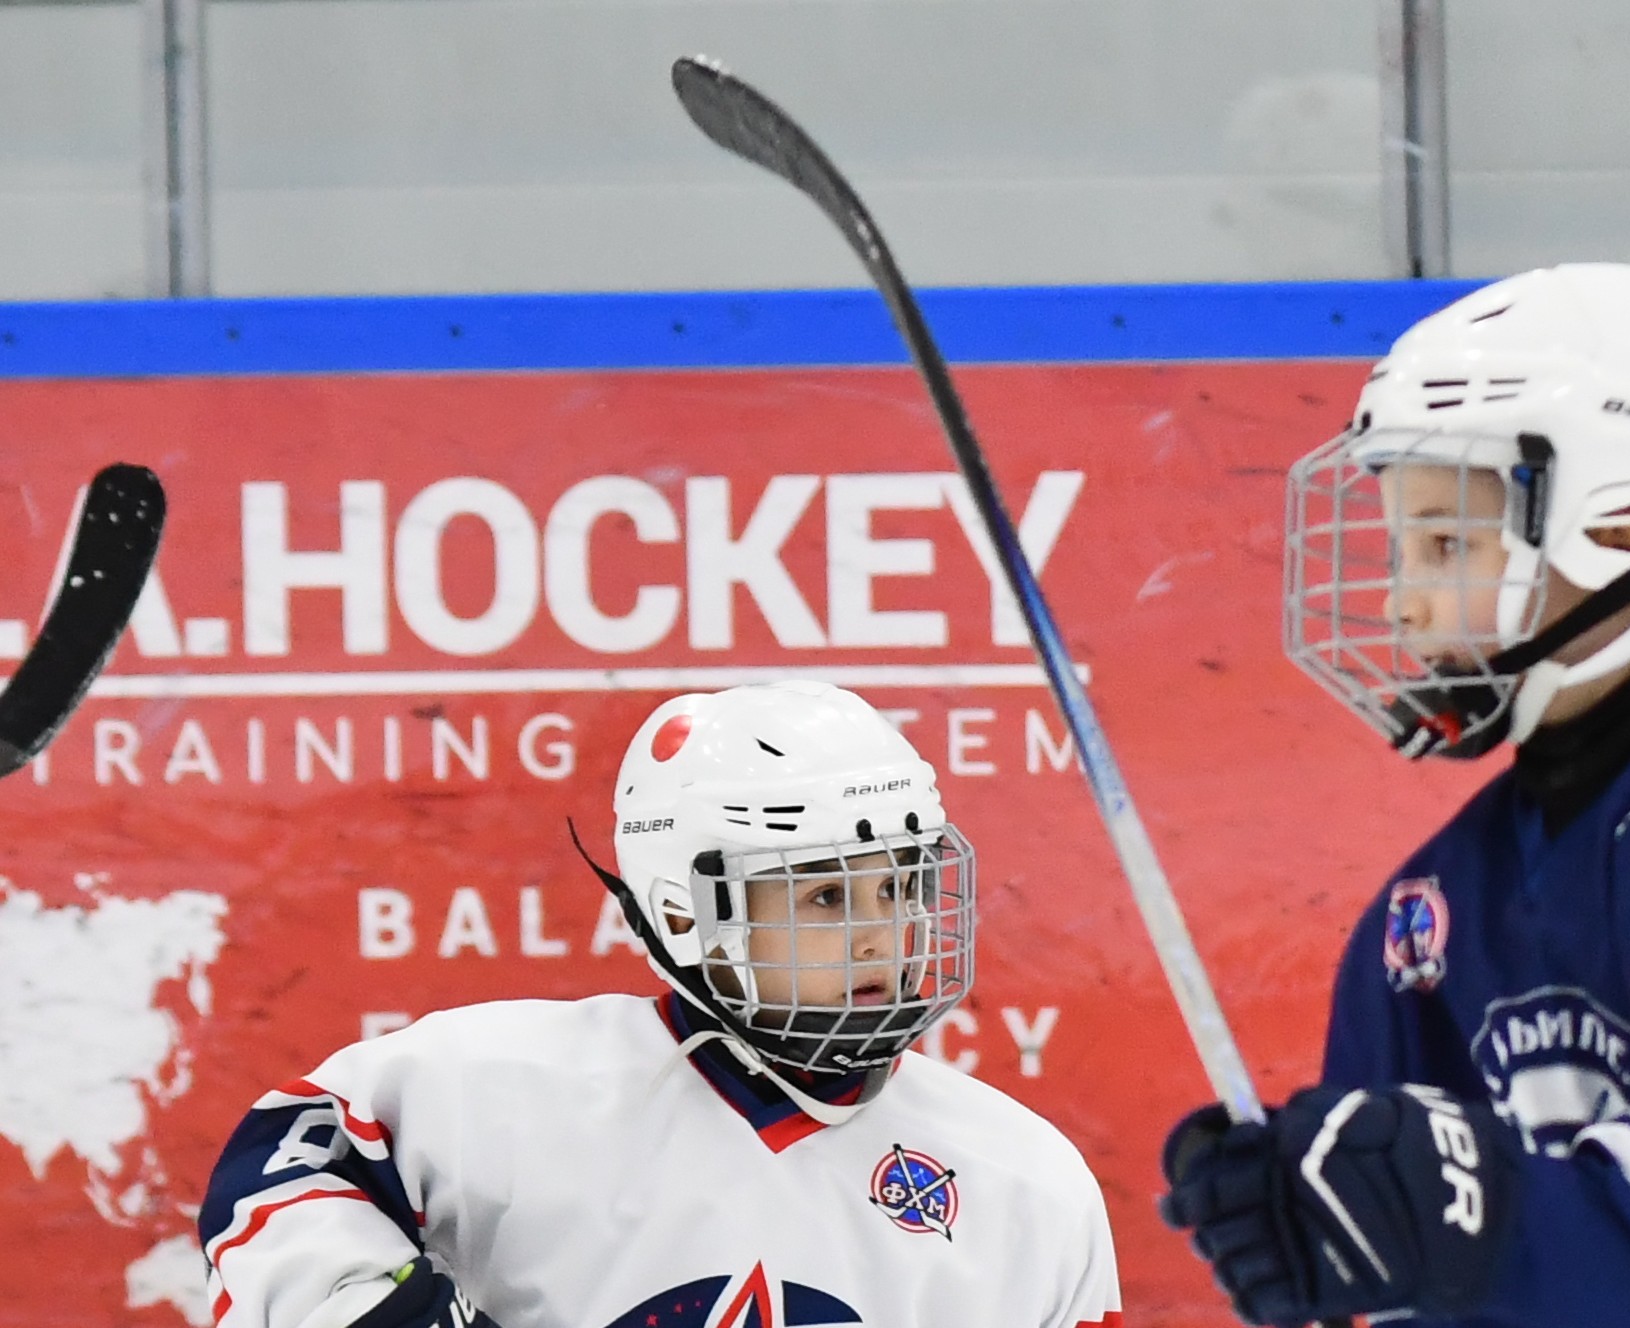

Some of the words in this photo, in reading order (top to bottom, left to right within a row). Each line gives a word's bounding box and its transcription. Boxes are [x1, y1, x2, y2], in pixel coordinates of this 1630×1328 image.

[32, 711, 577, 787] RAINING
[842, 777, 911, 798] BAUER
[622, 817, 675, 834] BAUER
